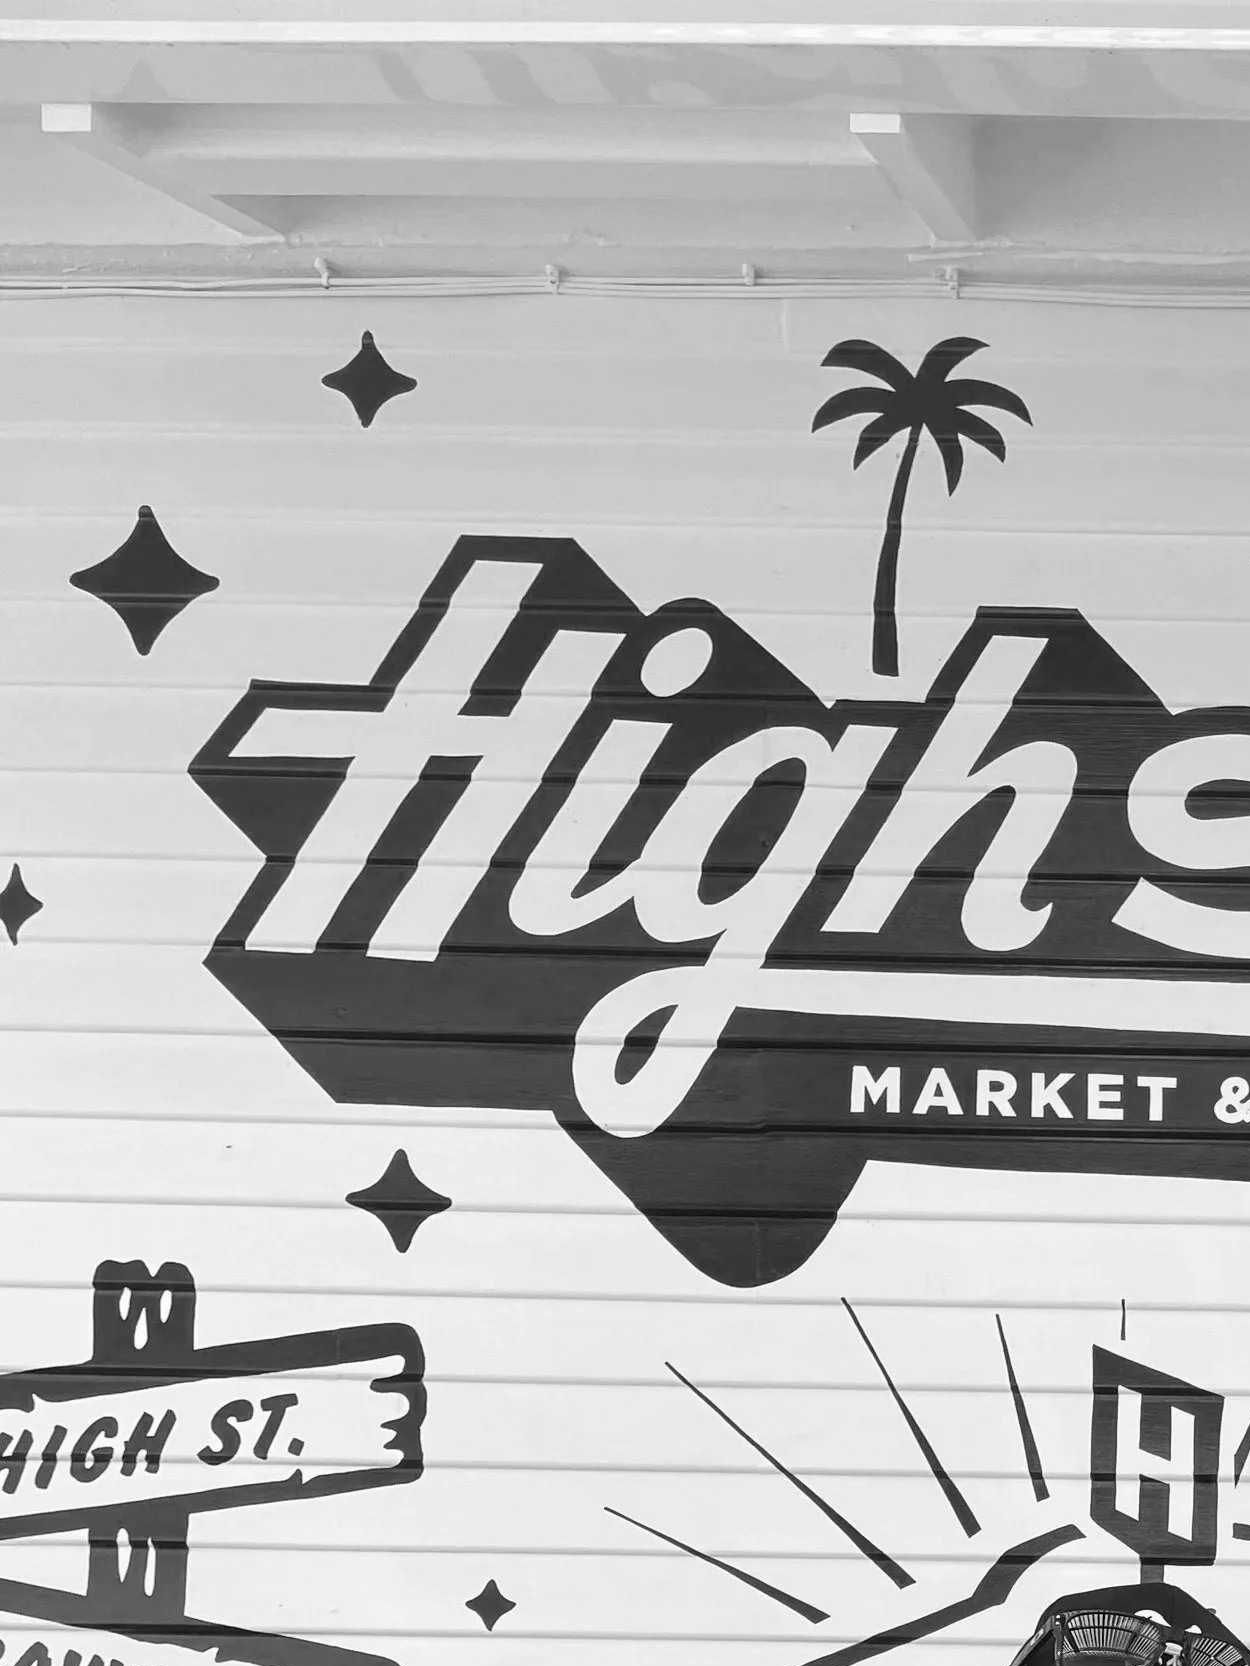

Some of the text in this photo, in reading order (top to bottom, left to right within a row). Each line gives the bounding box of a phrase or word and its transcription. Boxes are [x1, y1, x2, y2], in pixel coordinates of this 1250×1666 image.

[227, 559, 1078, 1138] High
[850, 1065, 1177, 1121] MARKET
[0, 1393, 304, 1494] HIGH ST.
